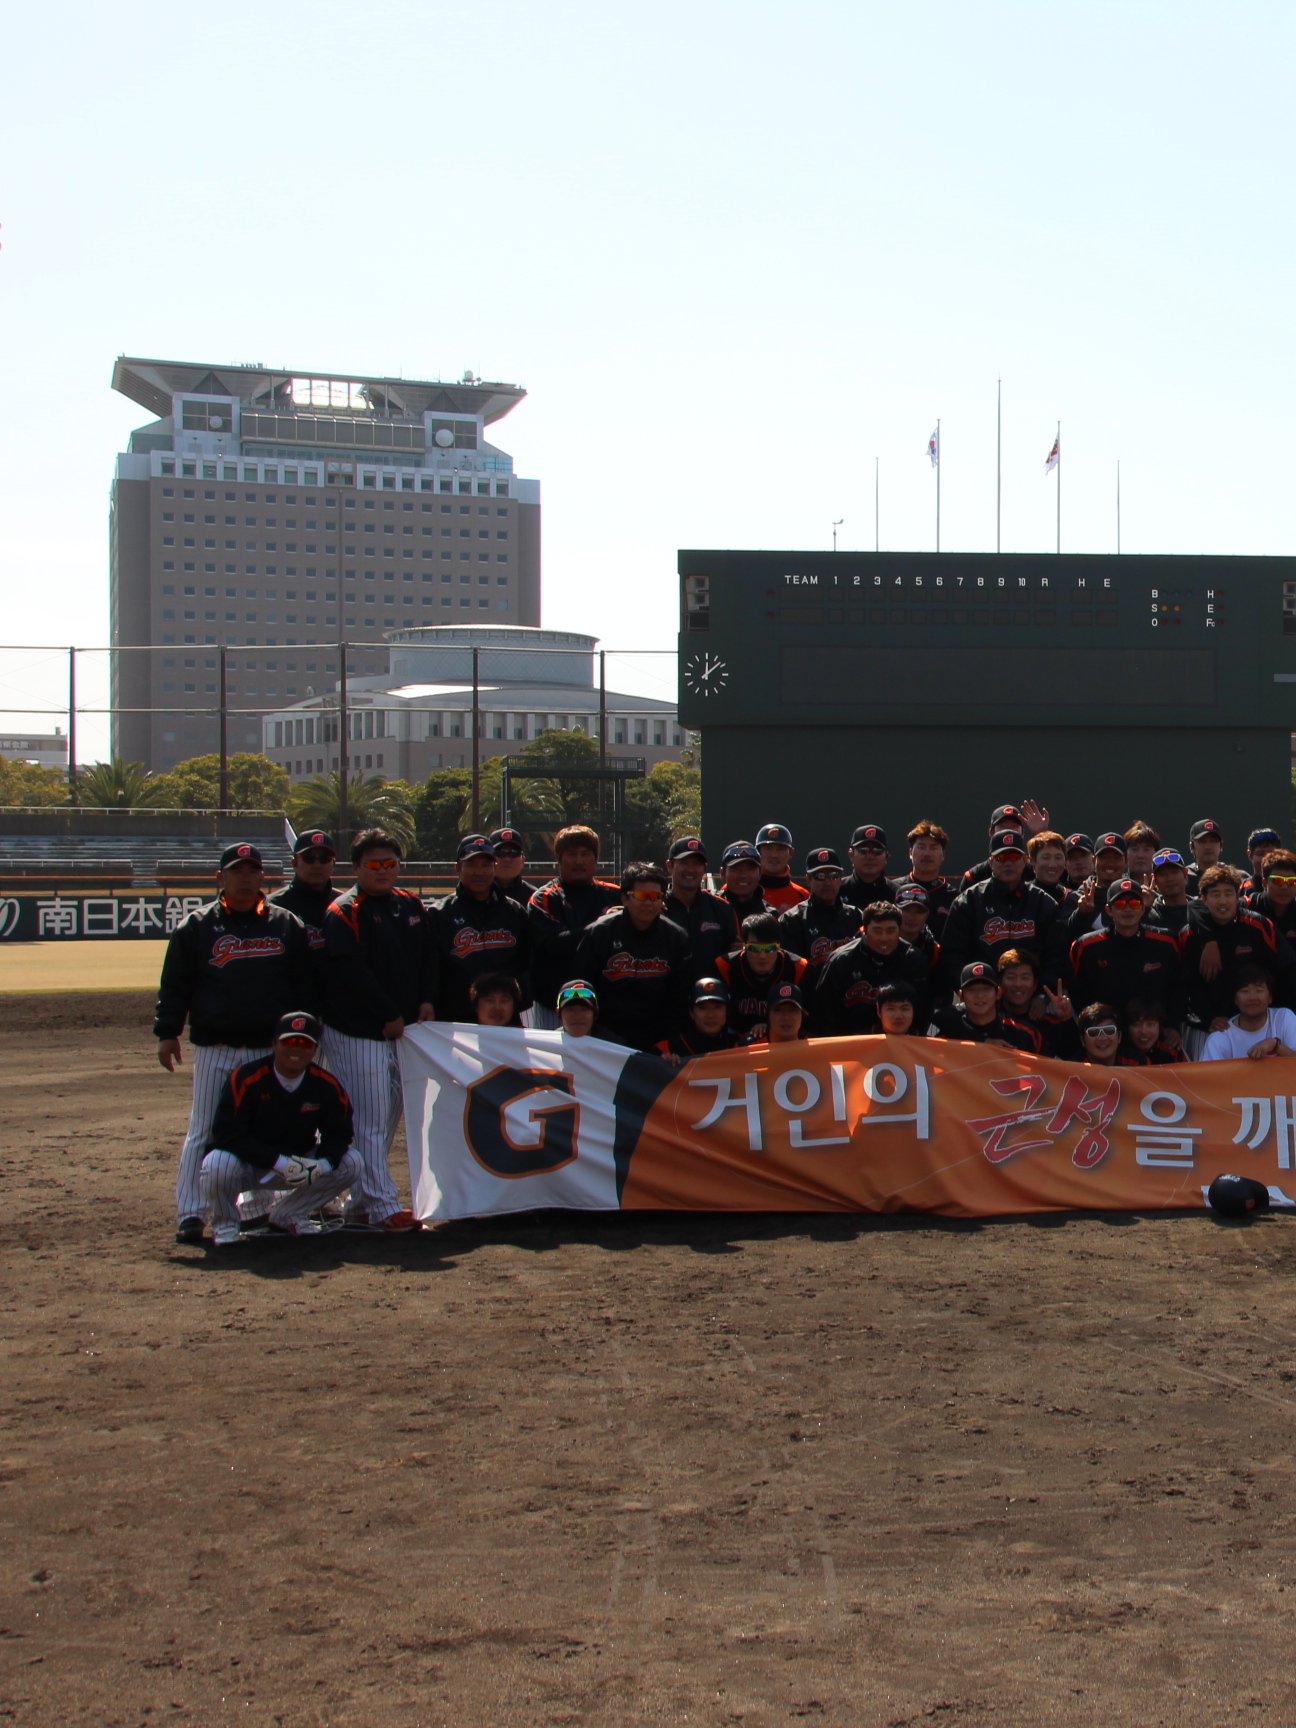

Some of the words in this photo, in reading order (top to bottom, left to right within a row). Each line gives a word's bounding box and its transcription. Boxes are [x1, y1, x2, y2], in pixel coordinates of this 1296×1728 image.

[784, 575, 819, 585] TEAM
[833, 576, 838, 585] 1
[853, 576, 861, 586] 2
[874, 576, 881, 586] 3
[894, 576, 902, 586] 4
[915, 577, 922, 586] 5
[936, 577, 943, 586] 6
[957, 577, 964, 586] 7
[977, 577, 984, 586] 8
[998, 578, 1005, 587] 9
[1018, 578, 1026, 587] 10
[1041, 578, 1049, 587] R
[1078, 578, 1086, 587] H
[1104, 578, 1111, 588] E
[1151, 589, 1159, 599] B
[1207, 590, 1214, 599] H
[1151, 604, 1158, 613] S
[1207, 604, 1214, 613] E
[209, 934, 285, 967] Giants
[688, 1062, 931, 1152] 거인의
[965, 1074, 1203, 1168] 근성을
[462, 1064, 582, 1180] G
